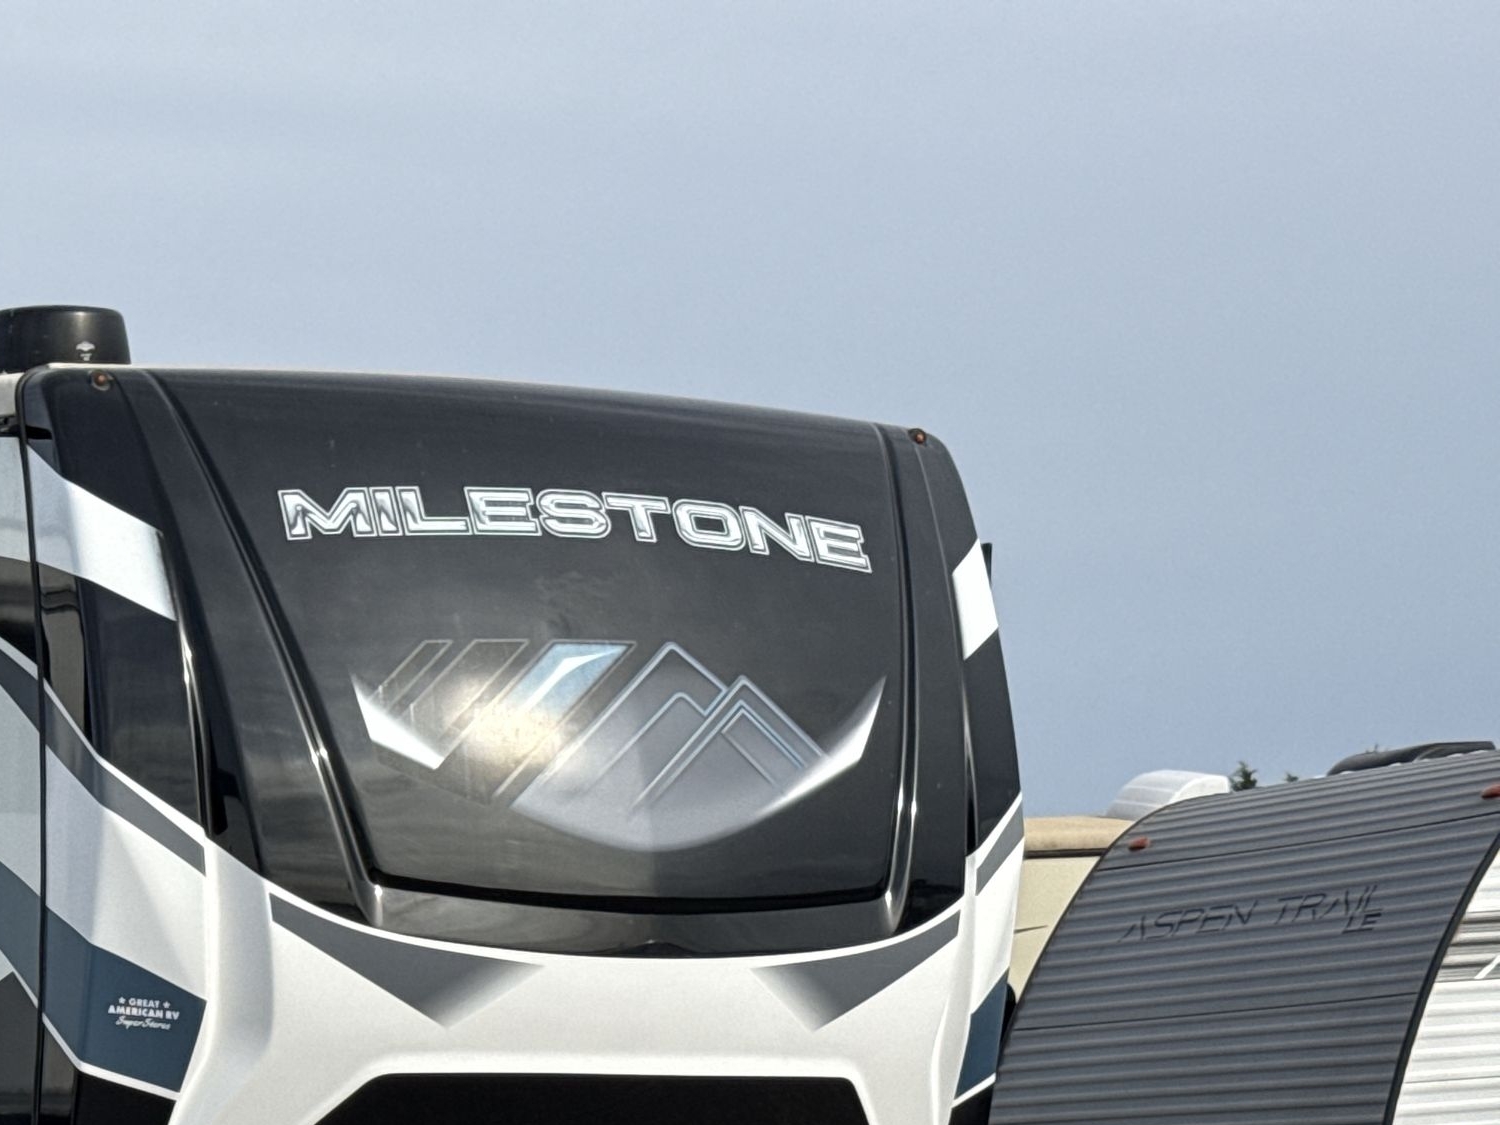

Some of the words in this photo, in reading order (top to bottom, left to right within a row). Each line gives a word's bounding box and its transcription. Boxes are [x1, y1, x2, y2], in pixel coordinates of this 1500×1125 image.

[276, 485, 873, 574] MILESTONE
[1117, 899, 1259, 943] ASPEN
[1273, 884, 1383, 925] TRAIL
[1342, 912, 1382, 934] LE
[107, 1004, 164, 1019] AMERICAN
[165, 1009, 180, 1020] RV
[128, 997, 160, 1009] GREAT
